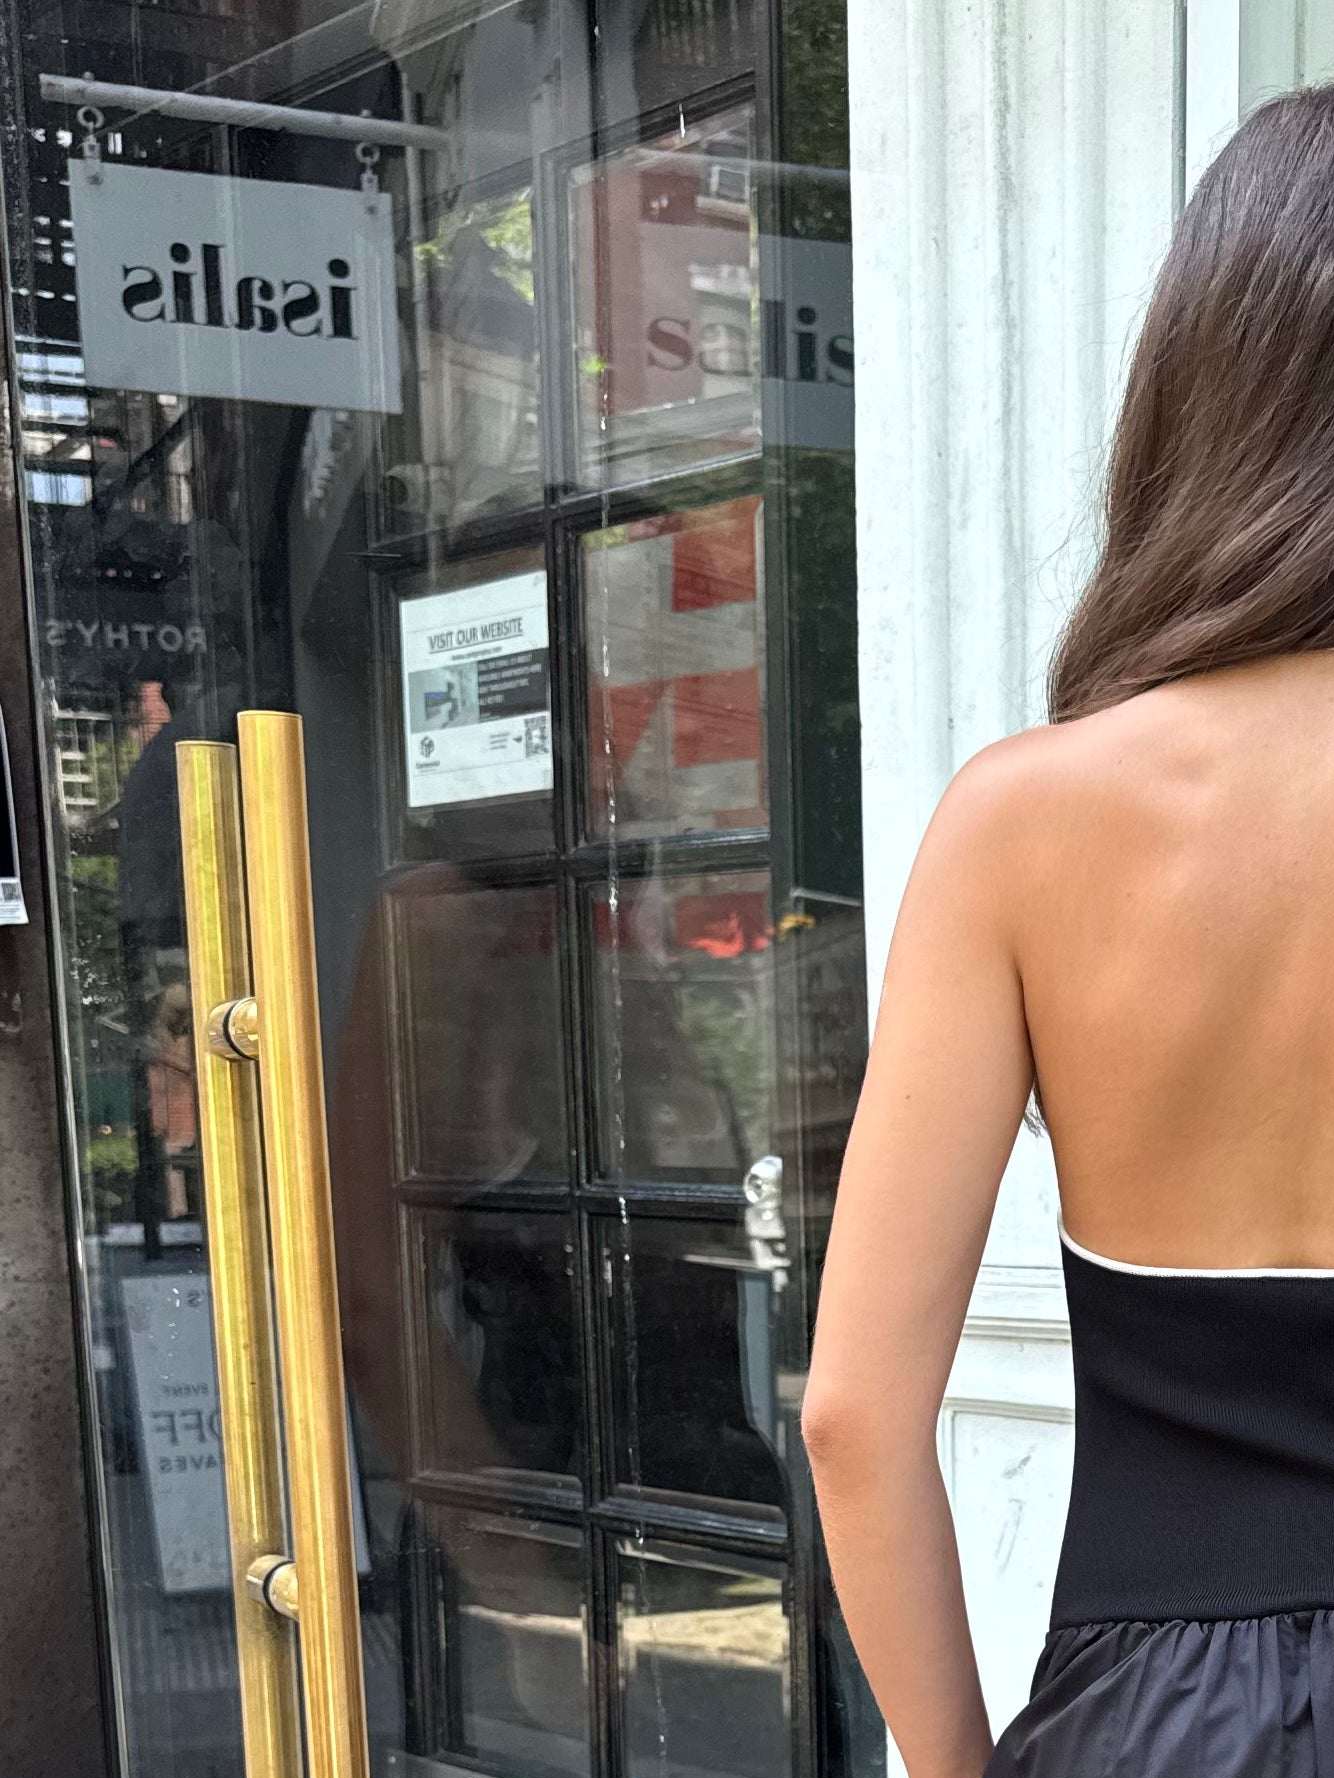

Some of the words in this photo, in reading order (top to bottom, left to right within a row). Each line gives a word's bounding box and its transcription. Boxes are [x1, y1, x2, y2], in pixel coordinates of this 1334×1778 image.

[427, 631, 454, 650] VISIT
[455, 626, 479, 646] OUR
[480, 616, 524, 640] WEBSITE
